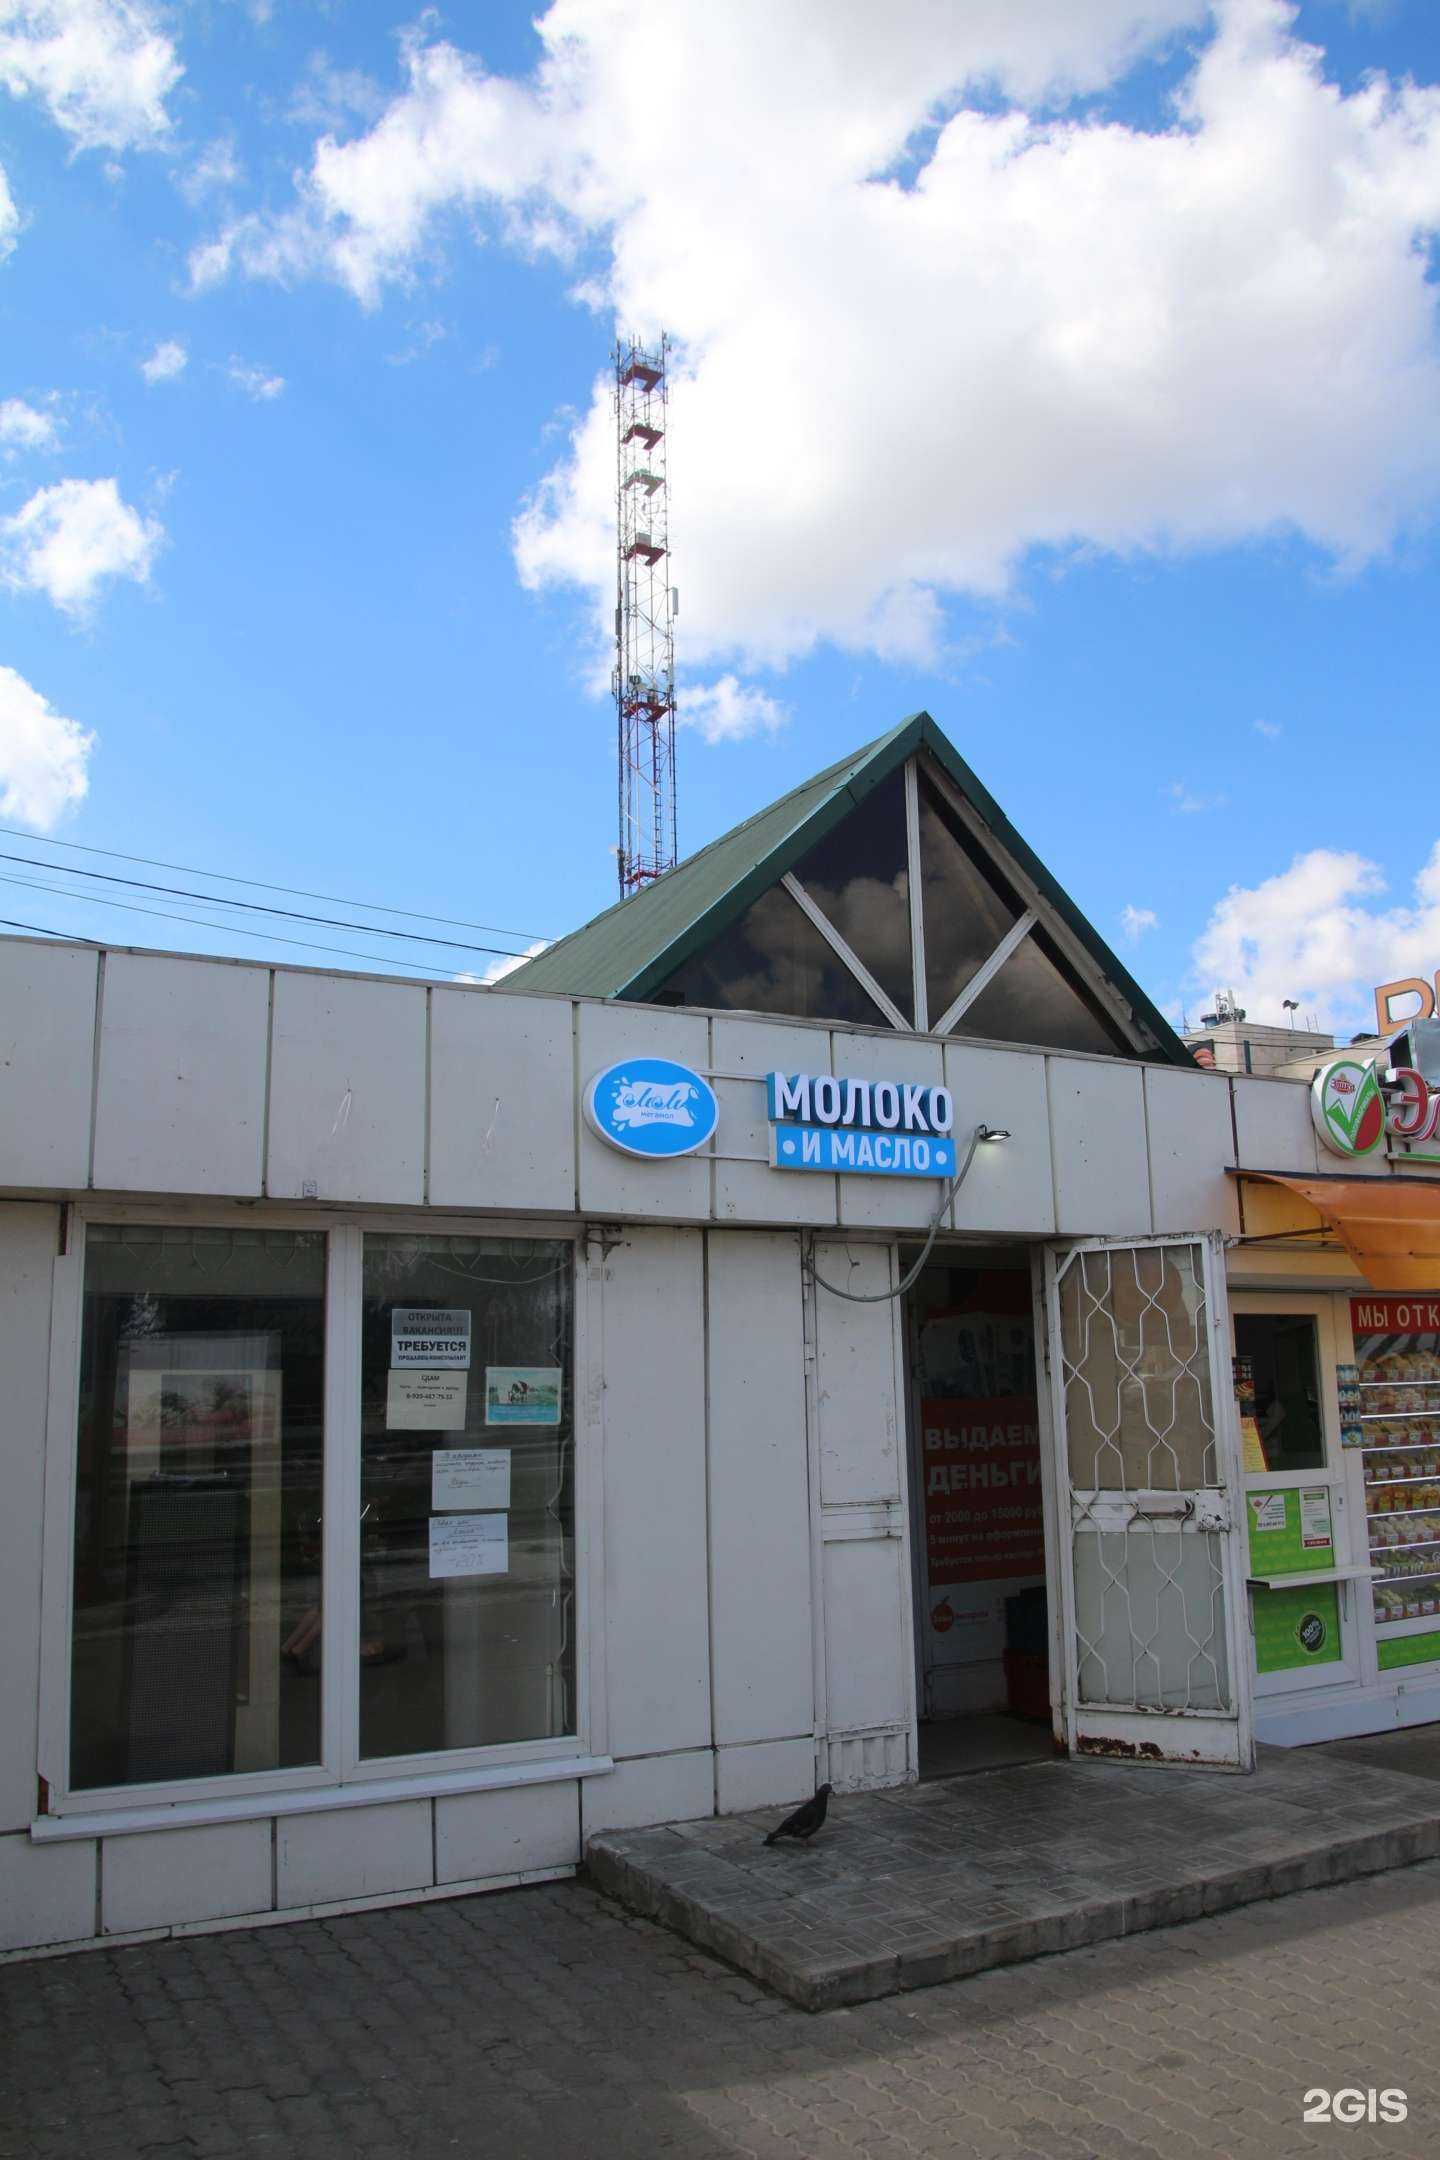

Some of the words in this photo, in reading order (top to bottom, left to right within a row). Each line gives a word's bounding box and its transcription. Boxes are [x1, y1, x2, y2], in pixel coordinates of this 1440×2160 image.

[770, 1072, 954, 1133] МОЛОКО
[802, 1131, 821, 1163] И
[831, 1133, 930, 1170] МАСЛО
[407, 1312, 452, 1321] ОТКРЫТА
[1358, 1304, 1389, 1328] МЫ
[1396, 1304, 1440, 1328] ОТК
[397, 1340, 467, 1352] ТРЕБУЕТСЯ
[925, 1424, 1039, 1452] ВЫДАЕМ
[928, 1460, 1041, 1496] ДЕНЬГИ
